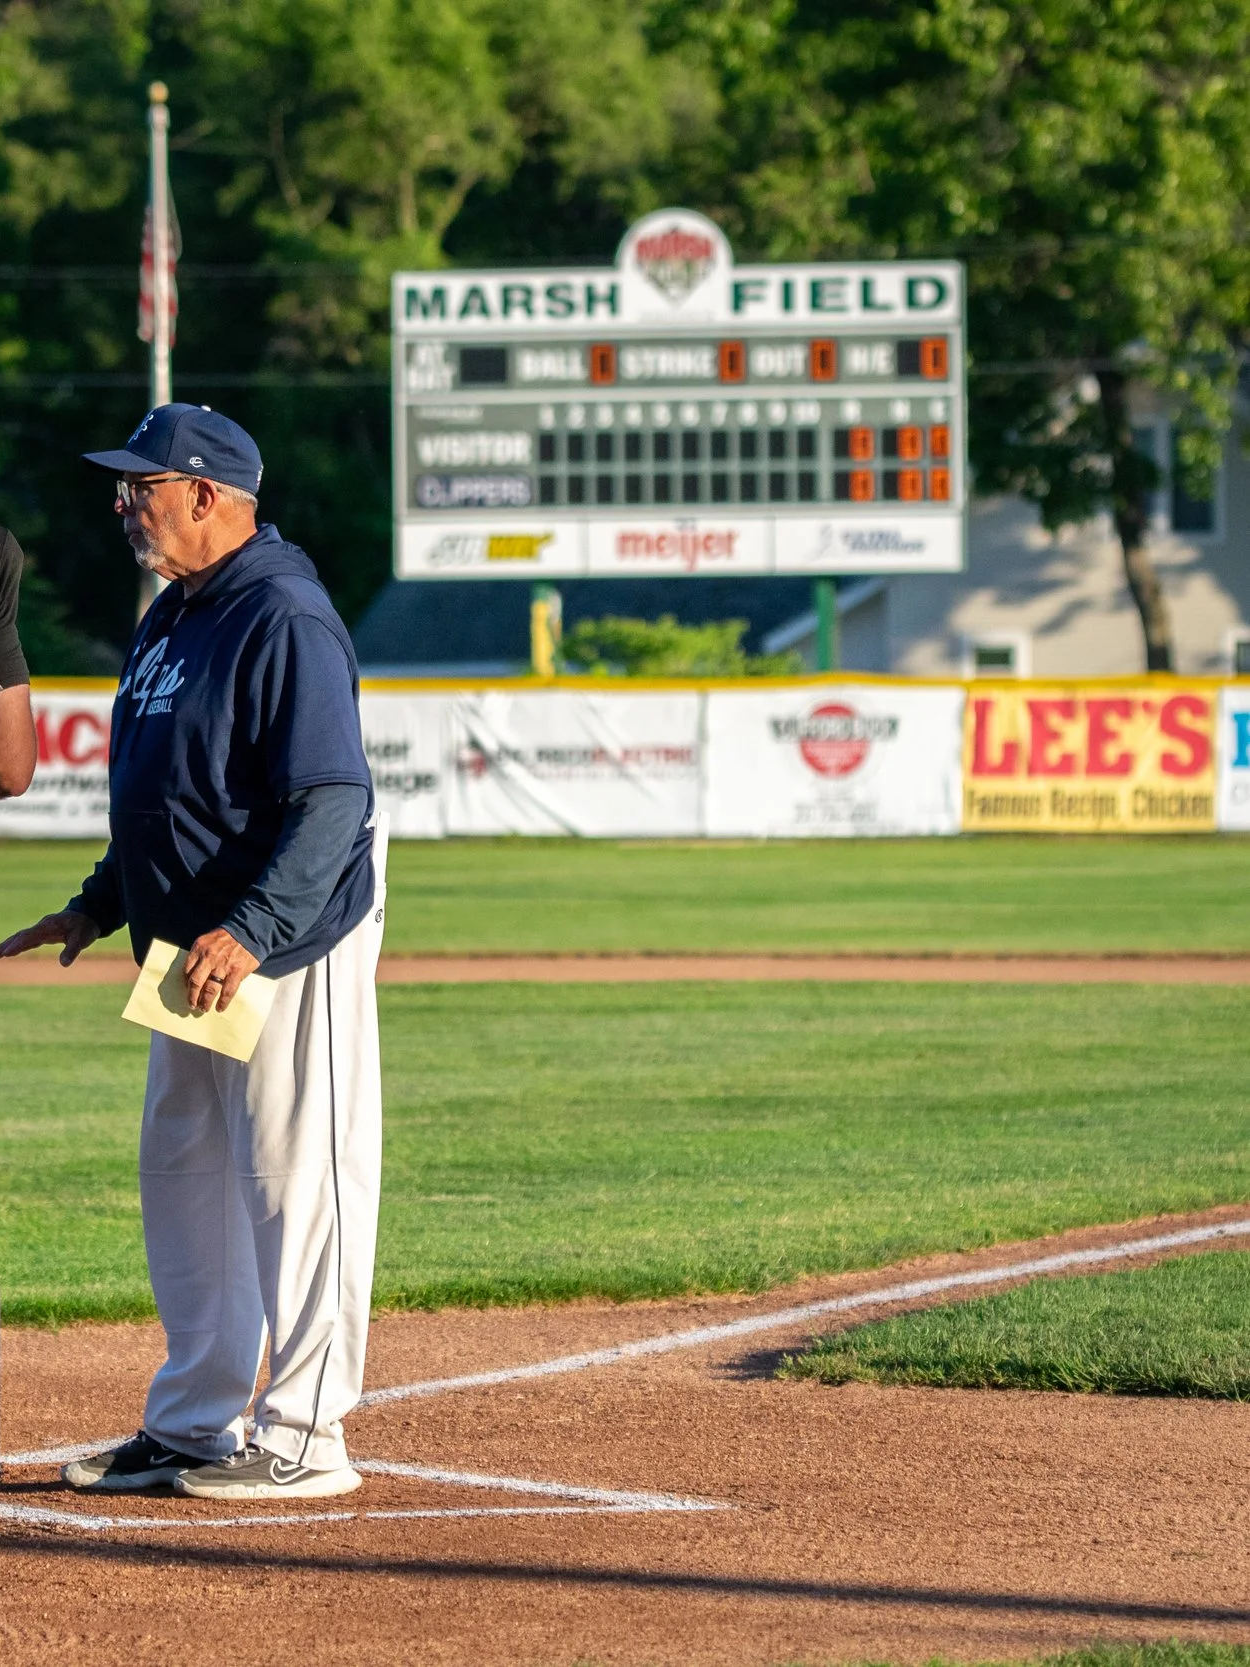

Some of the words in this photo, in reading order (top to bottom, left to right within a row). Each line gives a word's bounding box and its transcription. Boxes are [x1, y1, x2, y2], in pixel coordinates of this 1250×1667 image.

[405, 283, 619, 320] MARSH
[733, 276, 948, 314] FIELD
[619, 345, 717, 380] STRIKE
[751, 345, 808, 377] OUT
[416, 432, 531, 465] VISITOR
[616, 517, 738, 571] meijer
[971, 695, 1213, 777] LEE'S
[1131, 788, 1213, 818] Chicken
